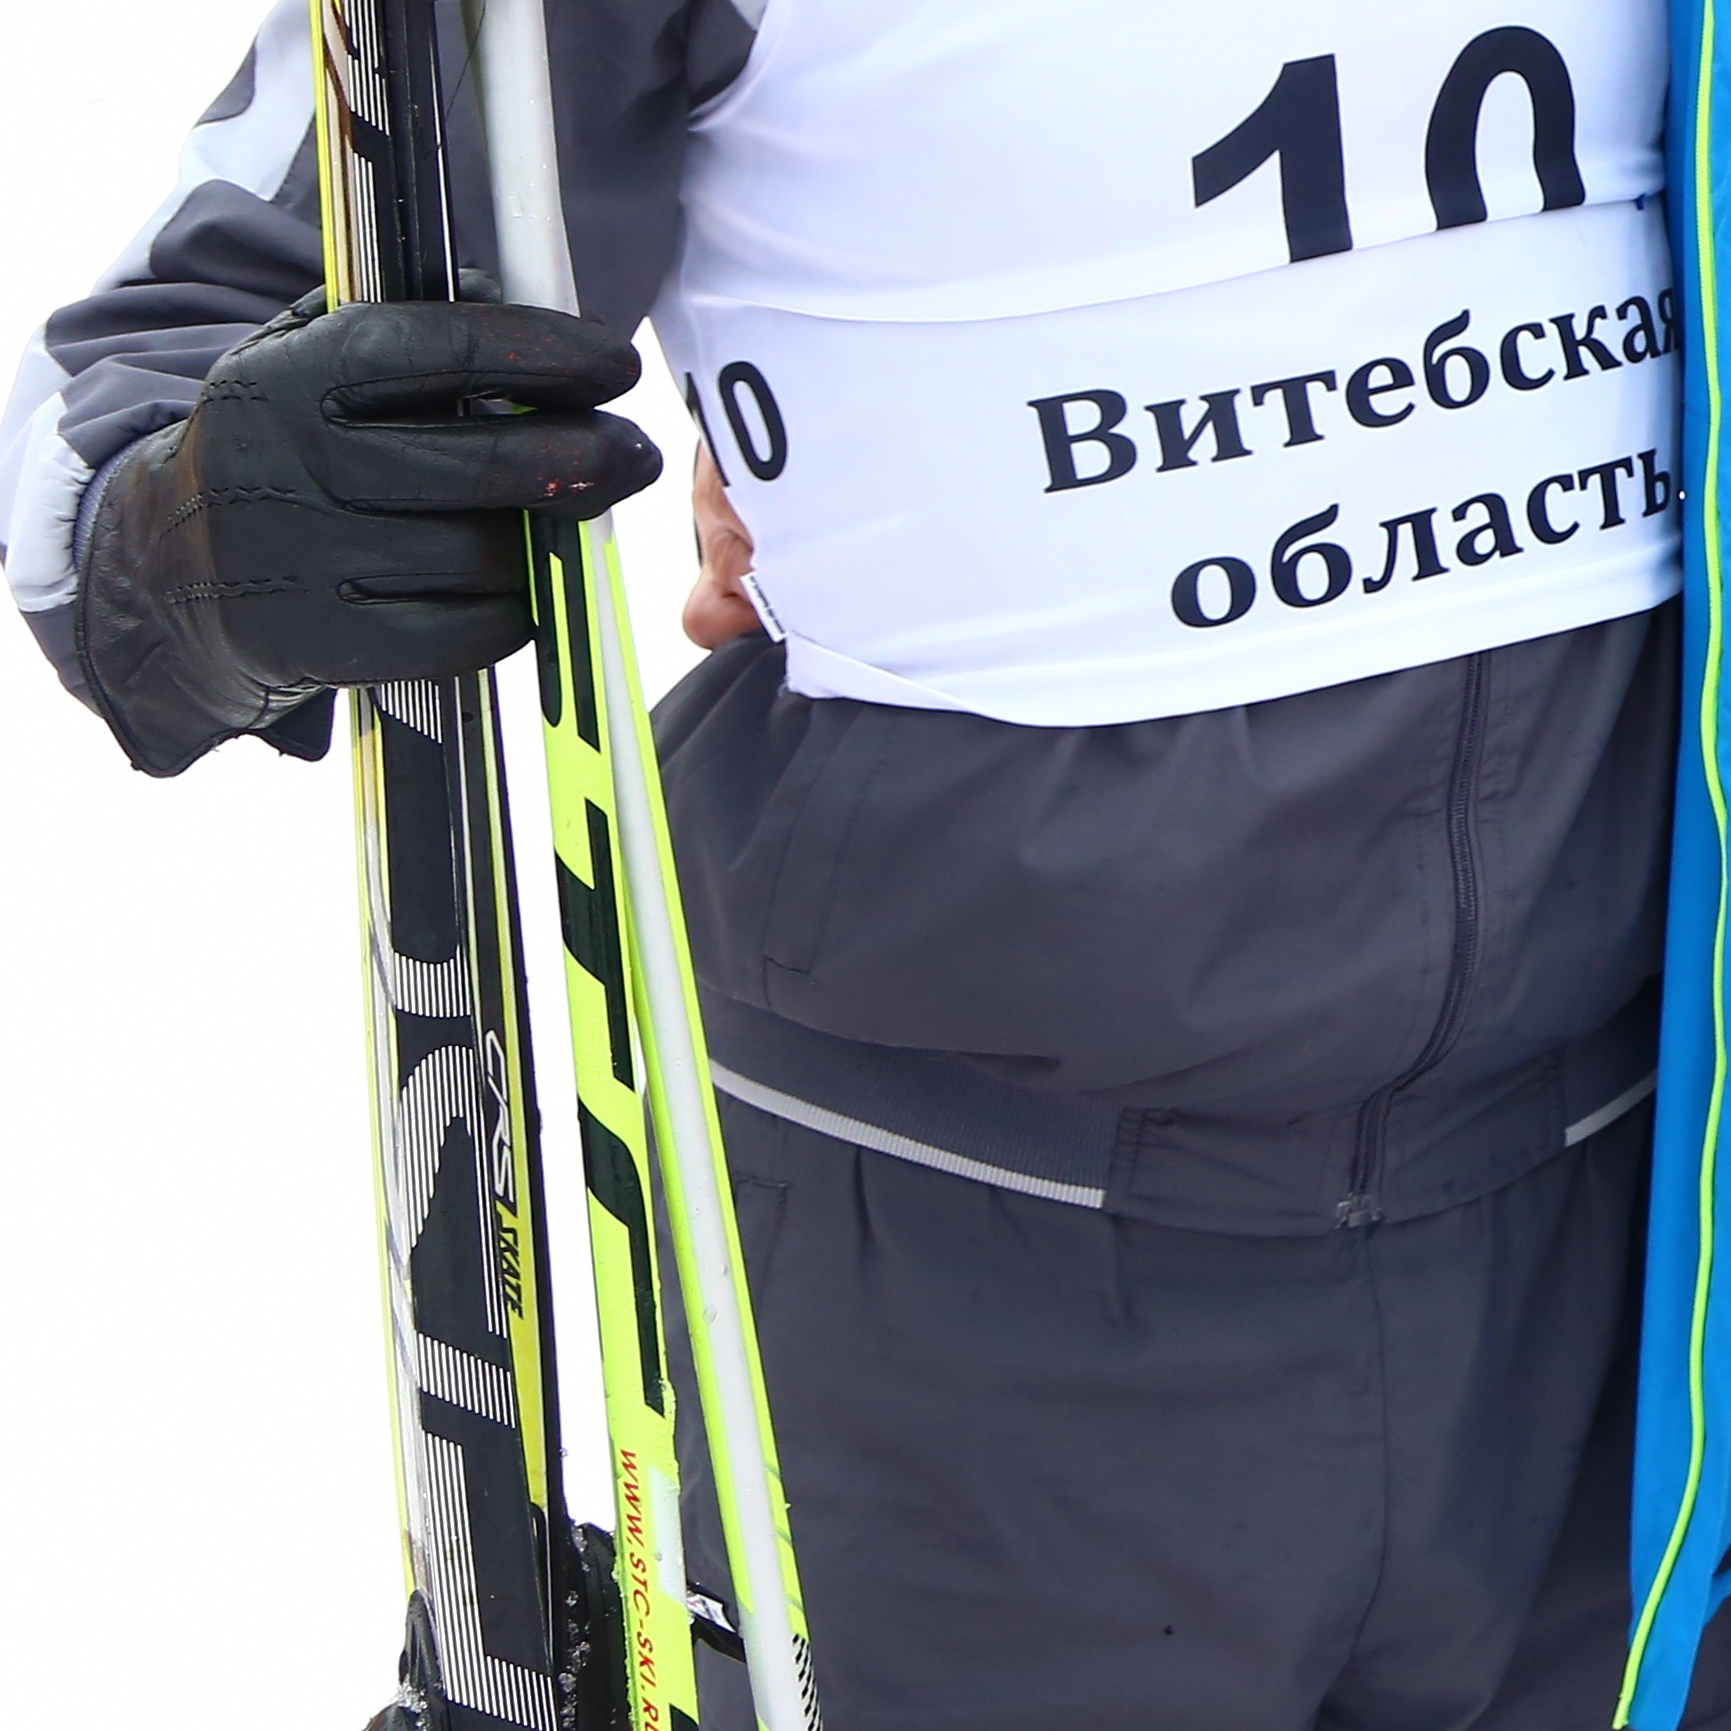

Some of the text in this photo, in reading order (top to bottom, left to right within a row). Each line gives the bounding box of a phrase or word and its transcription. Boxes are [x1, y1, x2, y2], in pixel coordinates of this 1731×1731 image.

[1190, 25, 1586, 263] 10
[1028, 285, 1678, 493] Витебская
[1169, 448, 1672, 631] область
[484, 1028, 514, 1202] CRS
